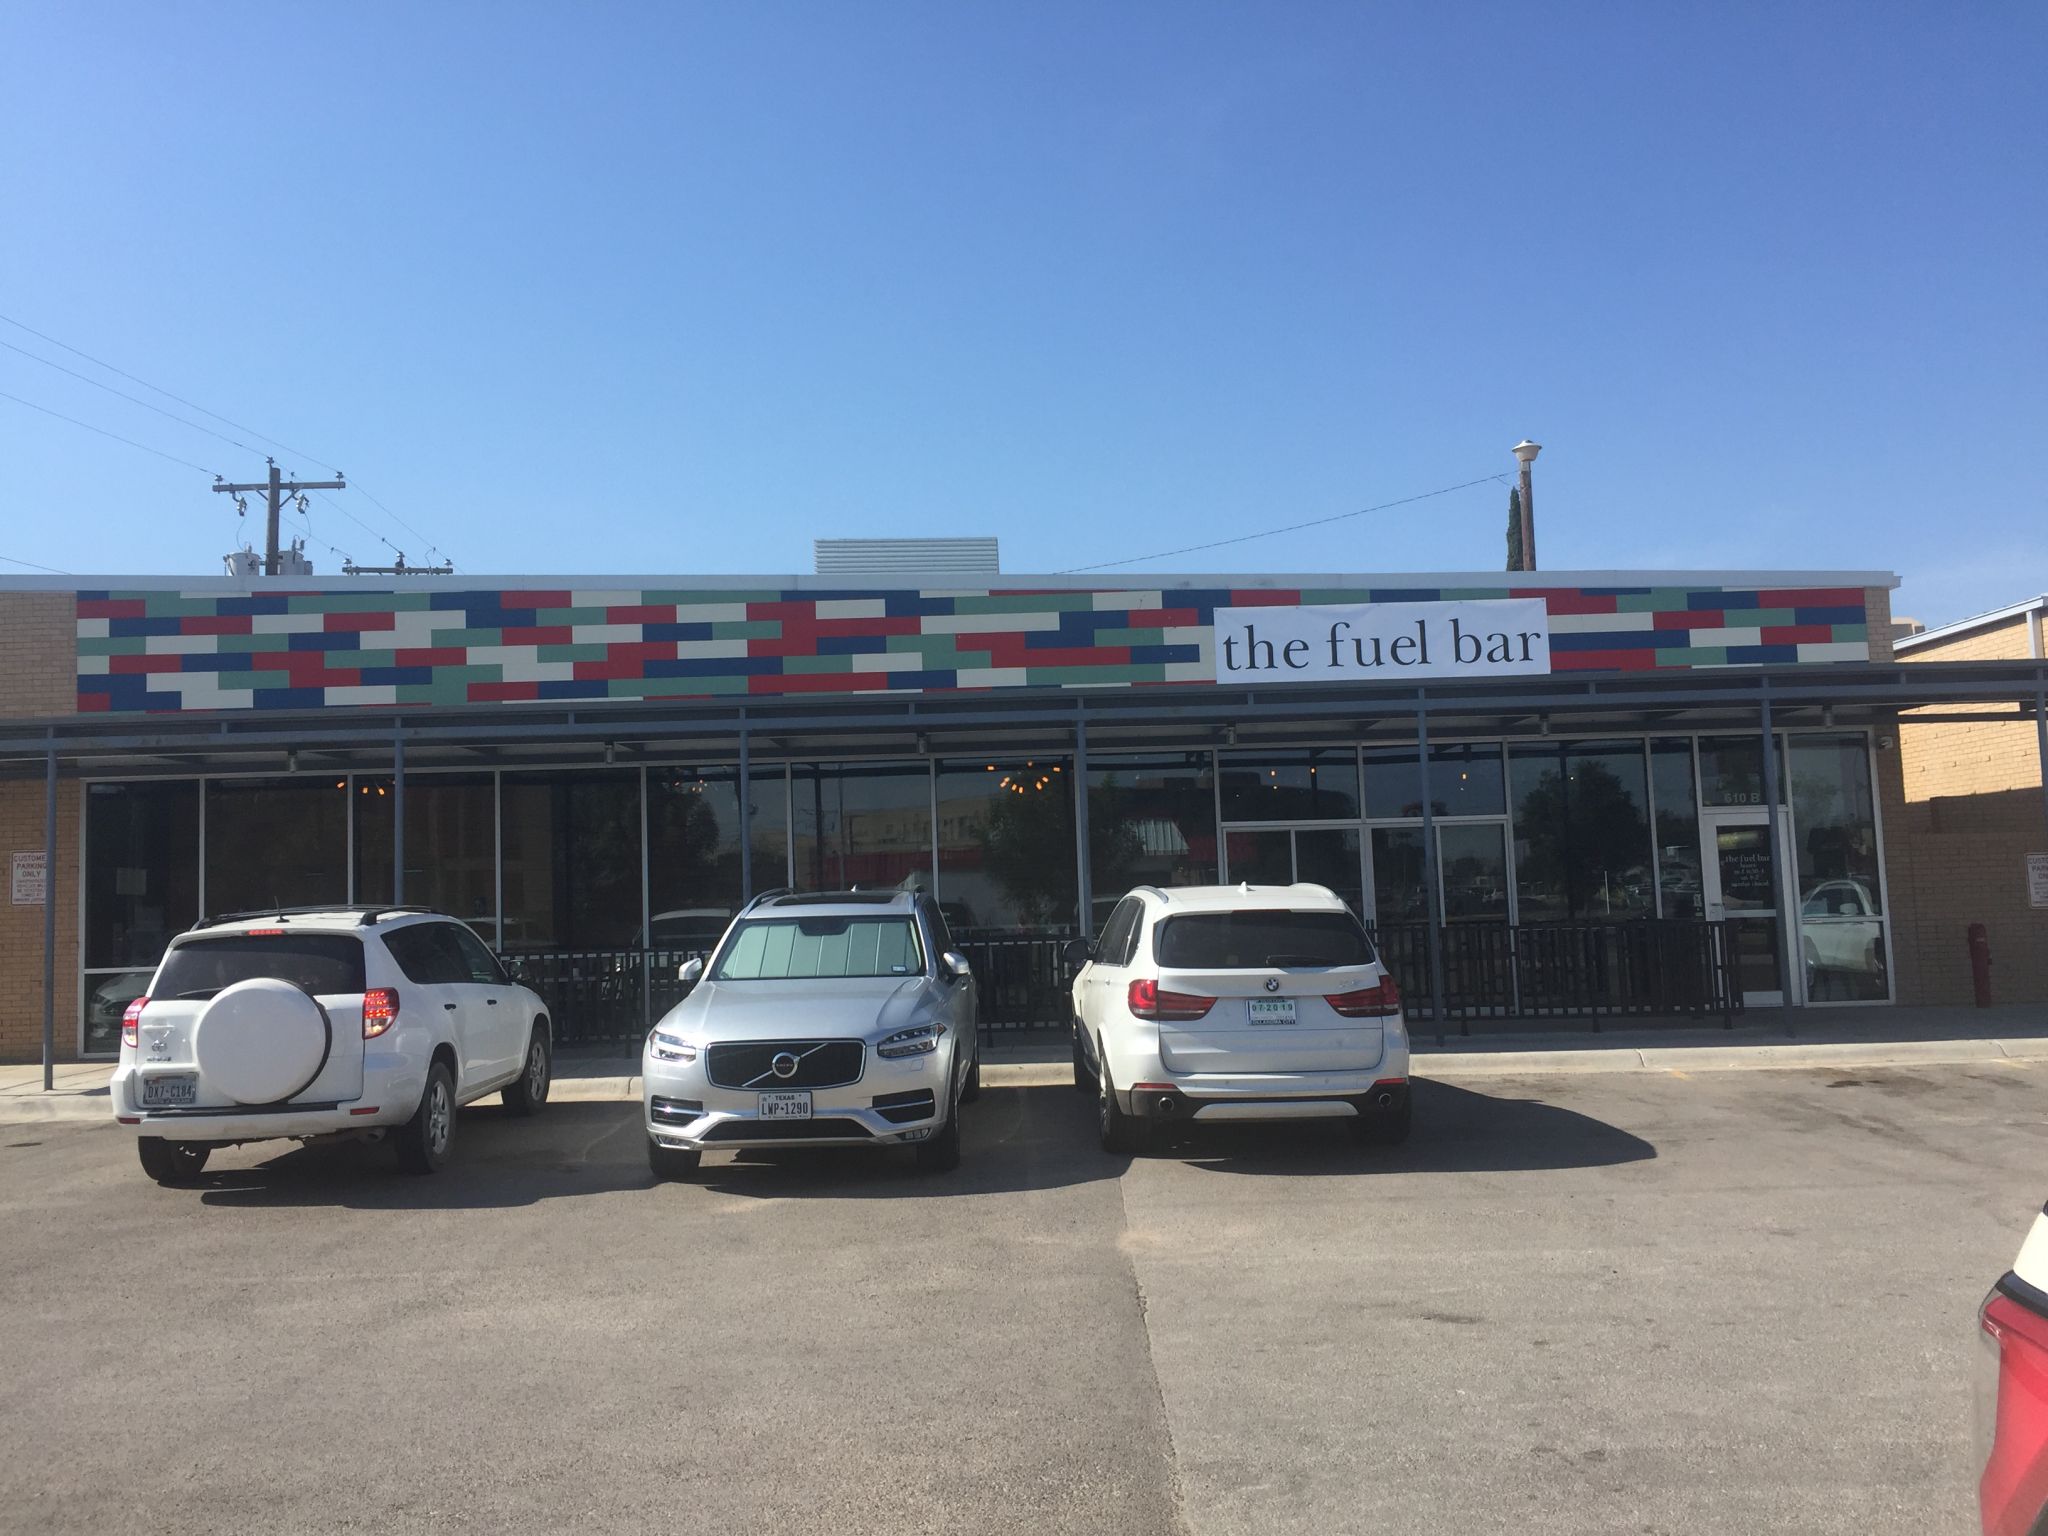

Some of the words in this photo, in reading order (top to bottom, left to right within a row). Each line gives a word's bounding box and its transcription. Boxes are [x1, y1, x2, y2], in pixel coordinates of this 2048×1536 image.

[1223, 624, 1309, 670] the
[1326, 619, 1432, 667] fuel
[1449, 618, 1541, 664] bar
[1725, 854, 1738, 863] the
[1740, 853, 1756, 863] fuel
